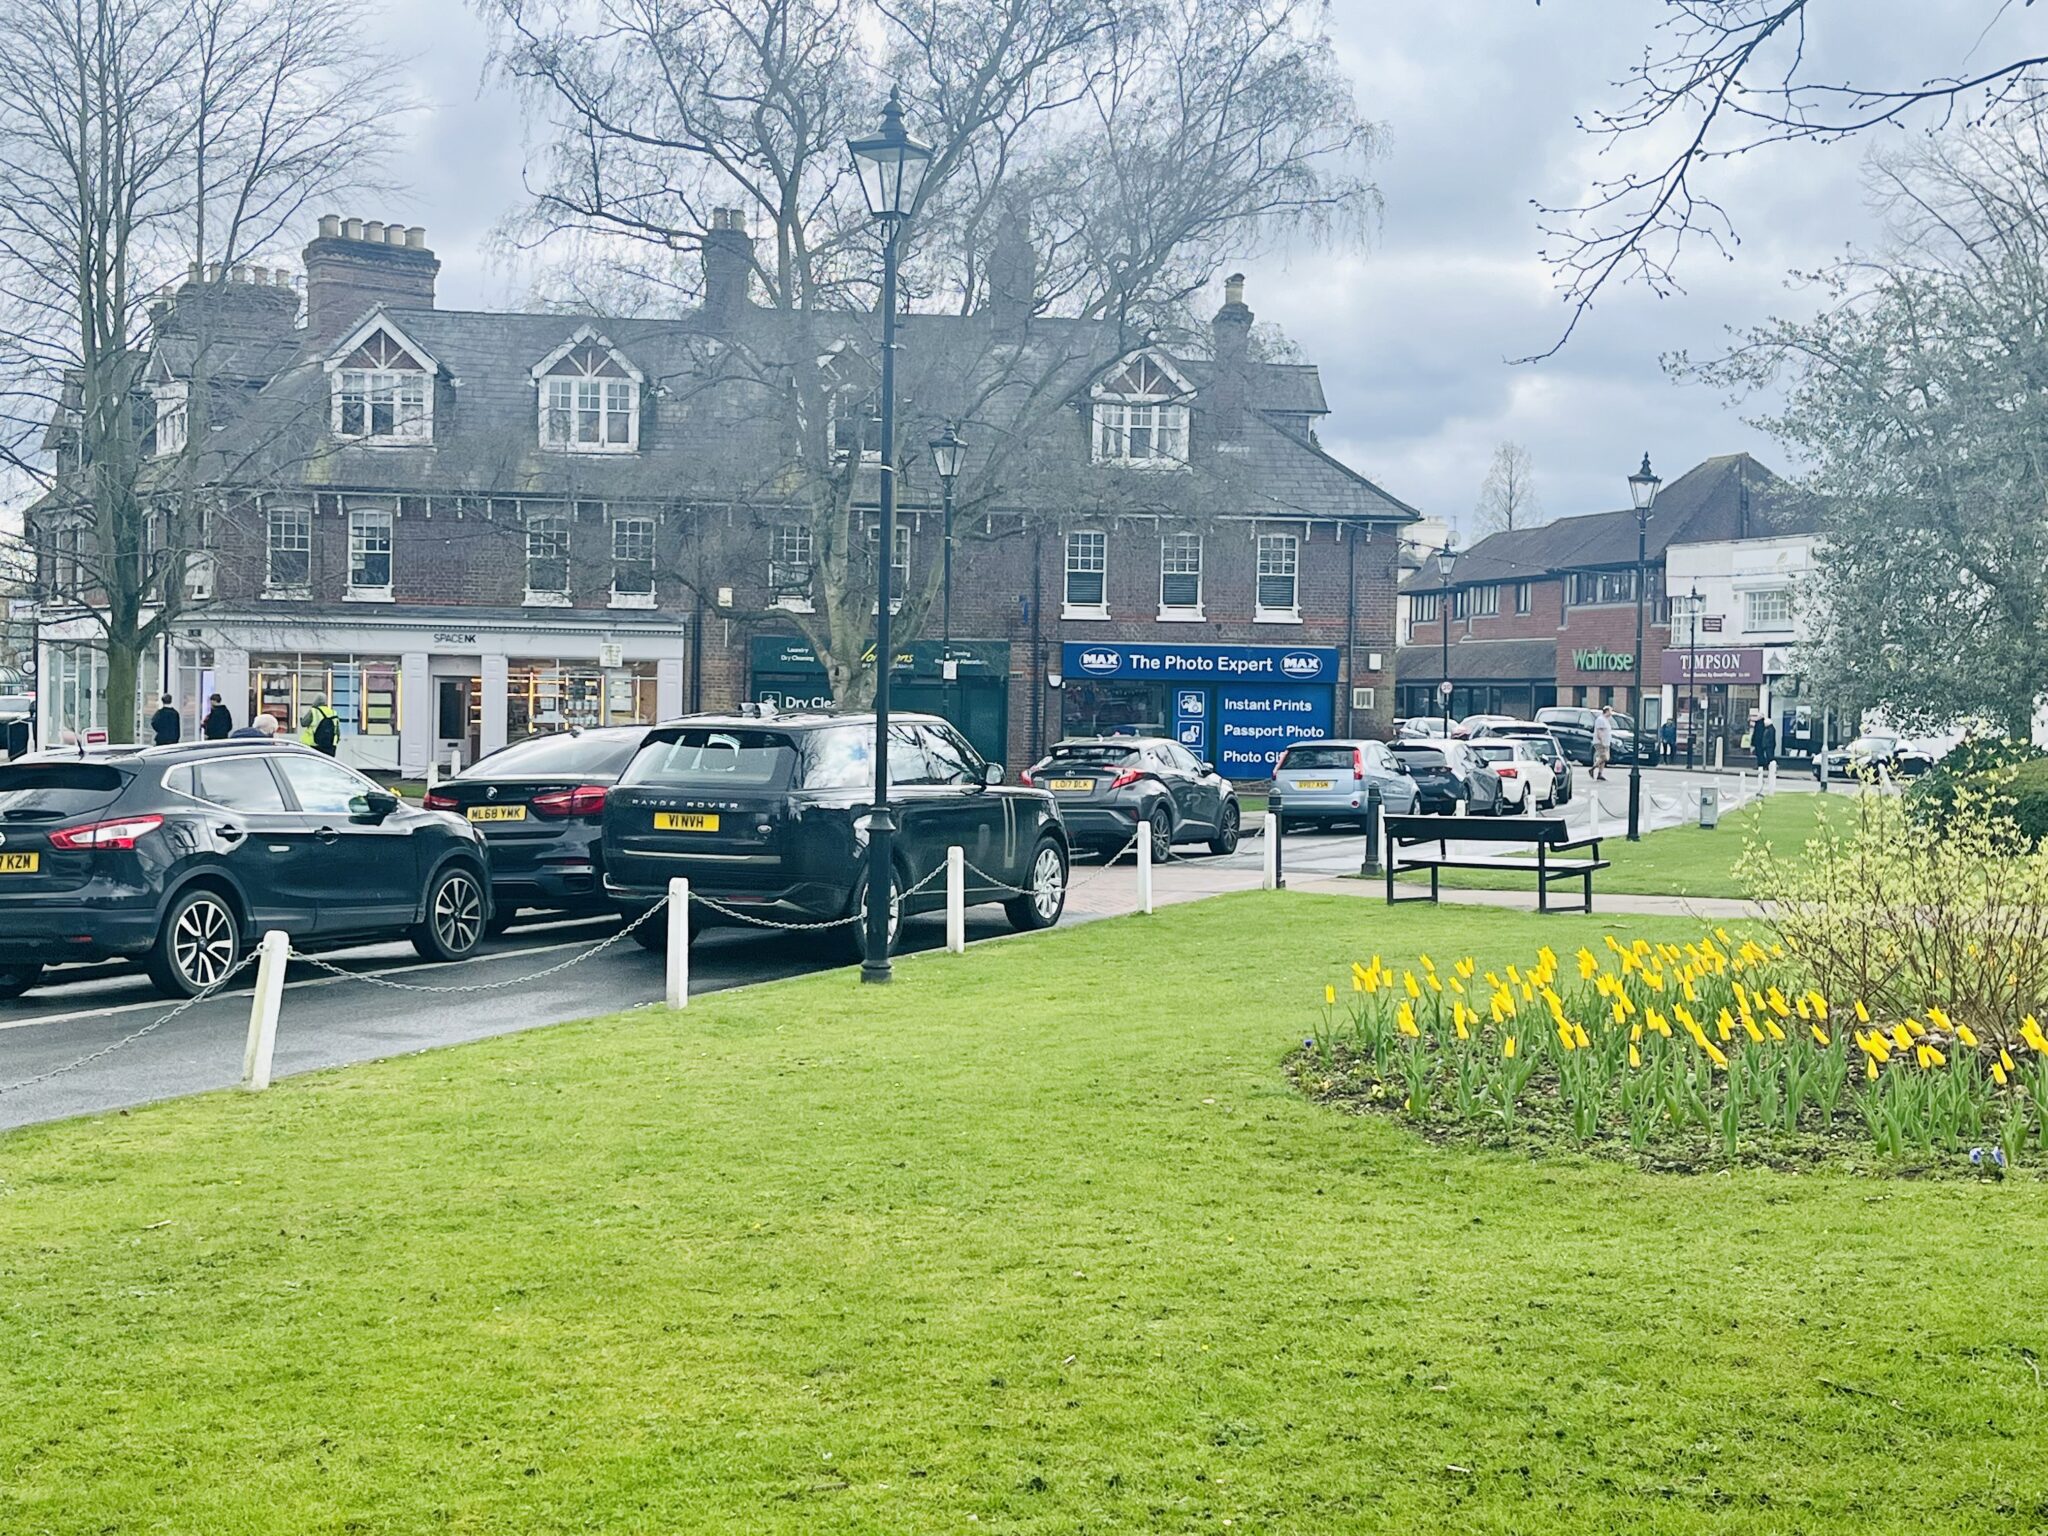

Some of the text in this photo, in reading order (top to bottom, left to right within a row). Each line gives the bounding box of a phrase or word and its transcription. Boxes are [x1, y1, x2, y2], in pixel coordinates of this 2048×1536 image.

[1083, 653, 1118, 665] MAX
[1129, 654, 1273, 674] The Photo Expert
[1284, 657, 1319, 669] MAX
[1571, 645, 1634, 671] Waitrose
[1680, 654, 1741, 669] TIMPSON
[785, 697, 808, 709] Dry
[1224, 698, 1312, 712] Instant Prints
[1224, 724, 1325, 739] Passport Photo
[1223, 751, 1261, 763] Photo
[632, 799, 739, 809] RANGE ROVER
[7, 854, 31, 869] KZM
